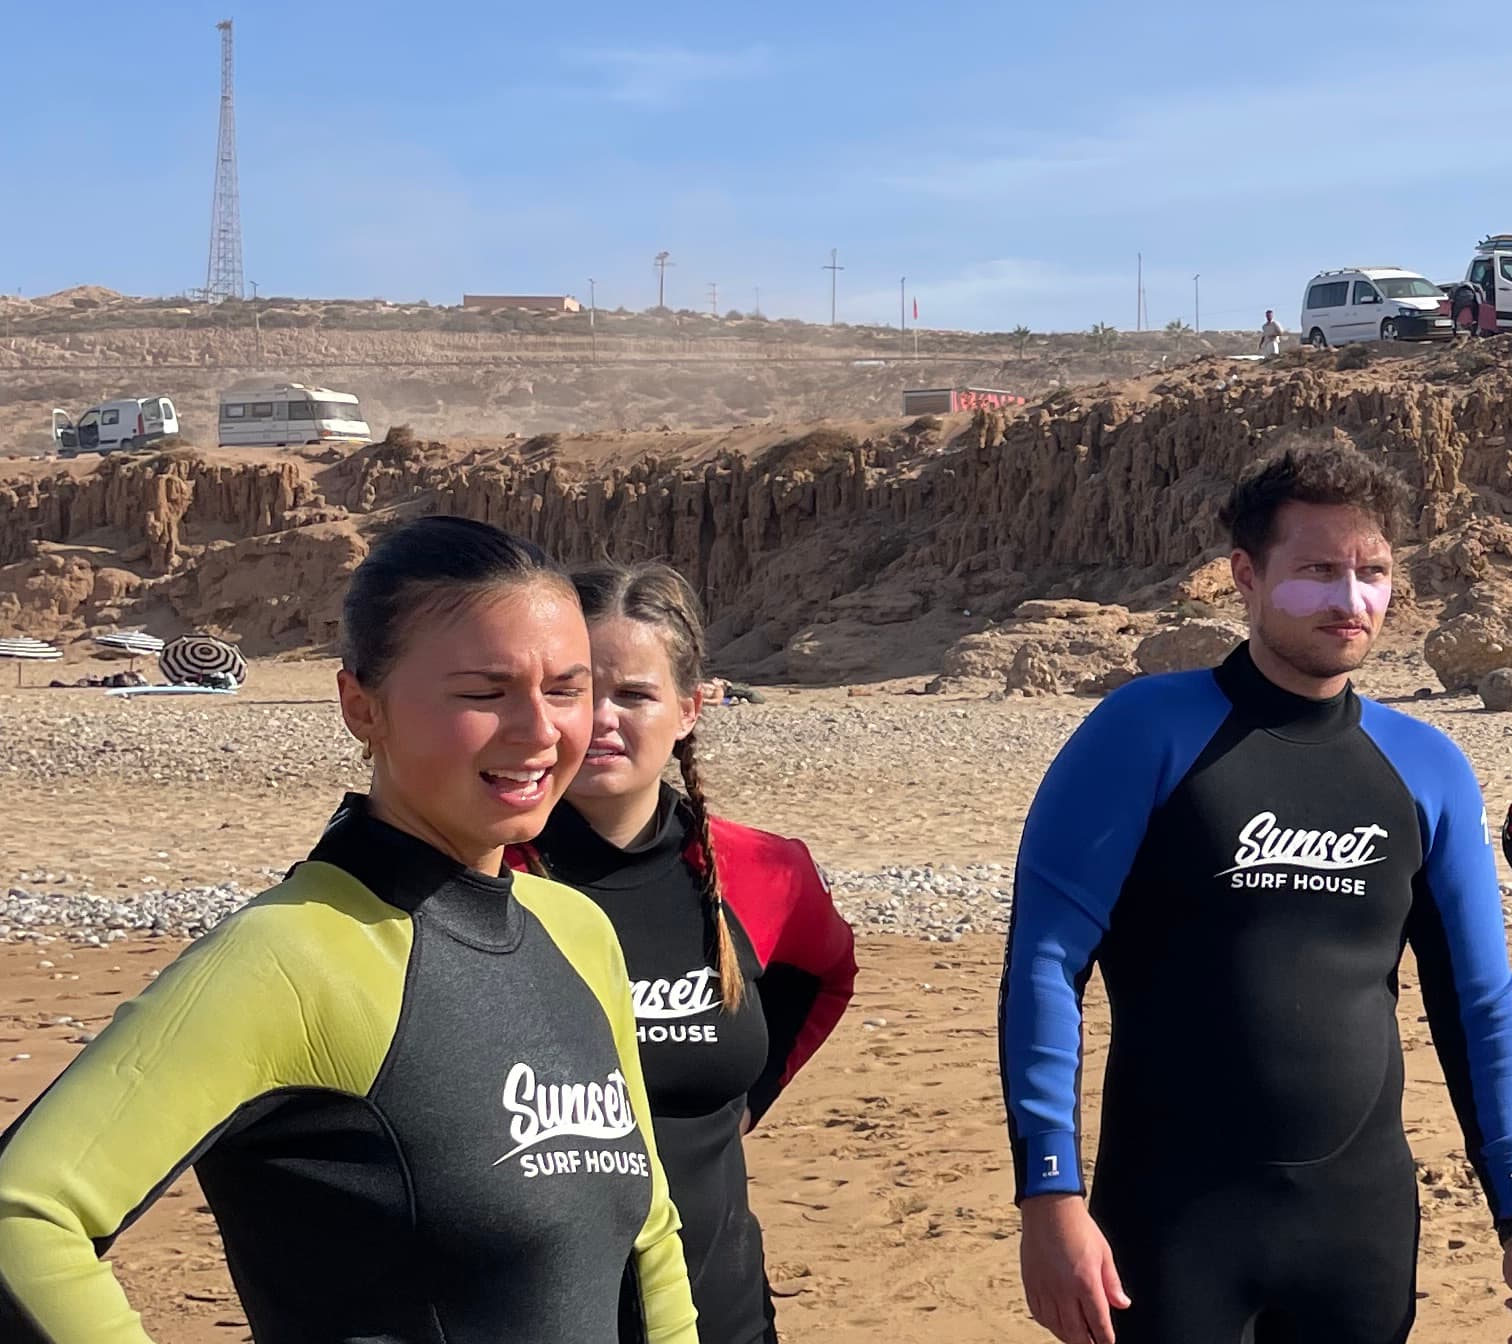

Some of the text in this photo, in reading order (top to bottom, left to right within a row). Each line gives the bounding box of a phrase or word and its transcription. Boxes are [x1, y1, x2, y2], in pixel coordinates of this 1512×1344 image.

[1235, 811, 1389, 866] Sunset
[1231, 873, 1366, 896] SURF HOUSE
[503, 1062, 637, 1144] Sunset
[520, 1150, 649, 1178] SURF HOUSE
